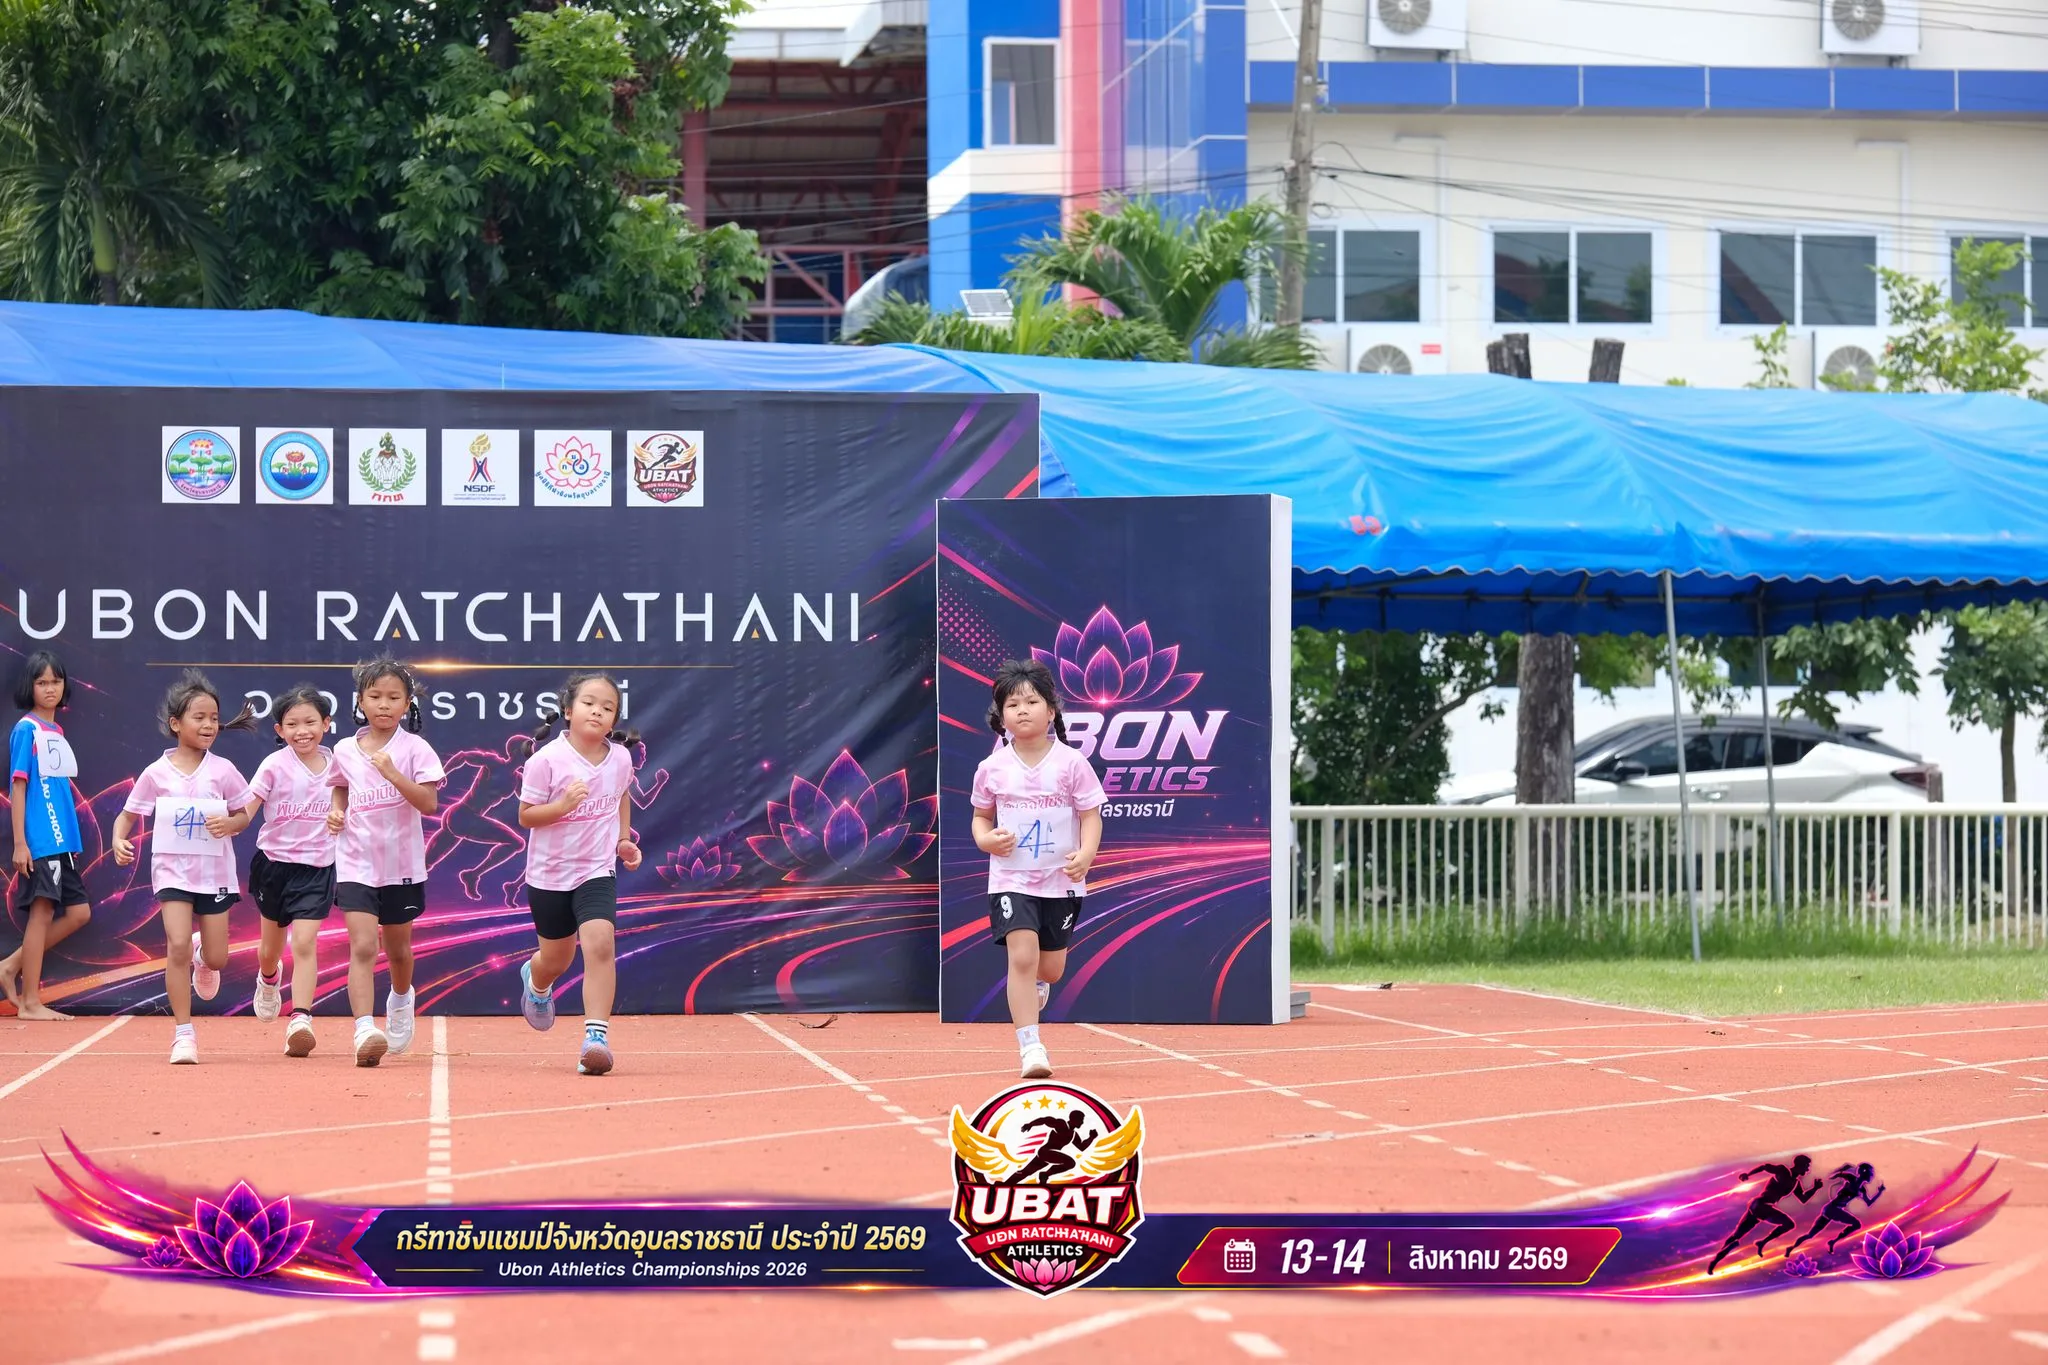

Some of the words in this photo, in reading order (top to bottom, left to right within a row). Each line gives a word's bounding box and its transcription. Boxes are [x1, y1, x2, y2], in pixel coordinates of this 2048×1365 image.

[463, 484, 496, 493] NSDF
[640, 469, 692, 483] UBAT
[18, 587, 268, 641] UBON
[316, 590, 859, 642] RATCHATHANI
[993, 711, 1229, 760] BON
[46, 739, 62, 771] 5
[1102, 766, 1216, 792] ETICS
[1098, 798, 1175, 817] ลราชธานี
[46, 801, 64, 848] SCHOOL
[1017, 819, 1055, 859] 4
[47, 860, 62, 886] 7
[1000, 895, 1014, 919] 9
